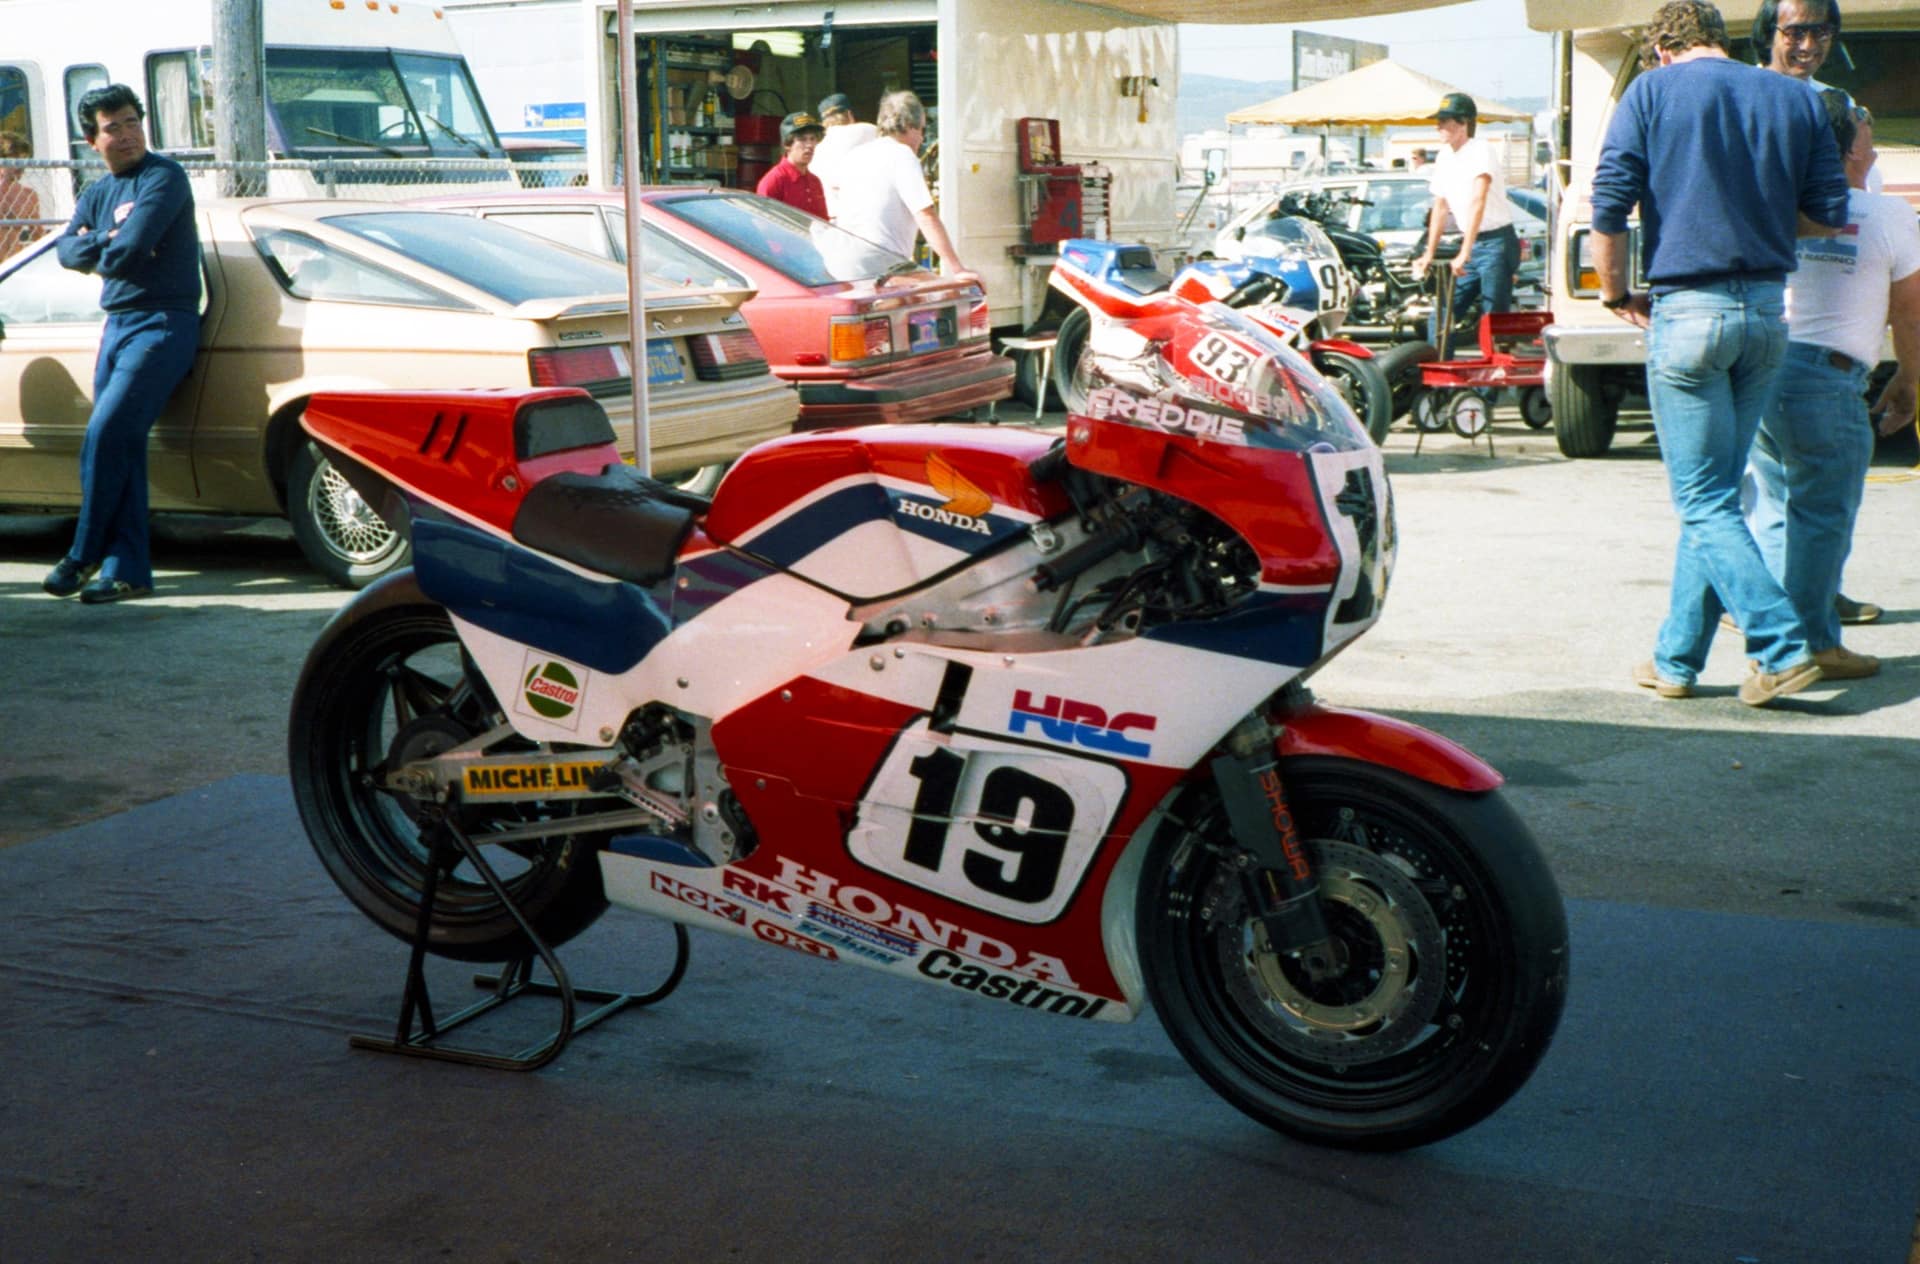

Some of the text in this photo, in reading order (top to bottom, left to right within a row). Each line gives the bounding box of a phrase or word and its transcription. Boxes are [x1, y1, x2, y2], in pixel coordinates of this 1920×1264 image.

[1196, 336, 1250, 383] 93
[1086, 387, 1245, 440] FREDDIE
[897, 498, 993, 537] HONDA
[530, 678, 578, 704] Castrol
[1008, 689, 1157, 758] HRC
[902, 745, 1076, 904] 19
[1260, 769, 1311, 881] SHOWA
[654, 876, 735, 921] NGK
[722, 868, 794, 913] RK
[757, 924, 831, 958] OKI
[773, 855, 1080, 990] HONDA
[918, 949, 1107, 1019] Castrol
